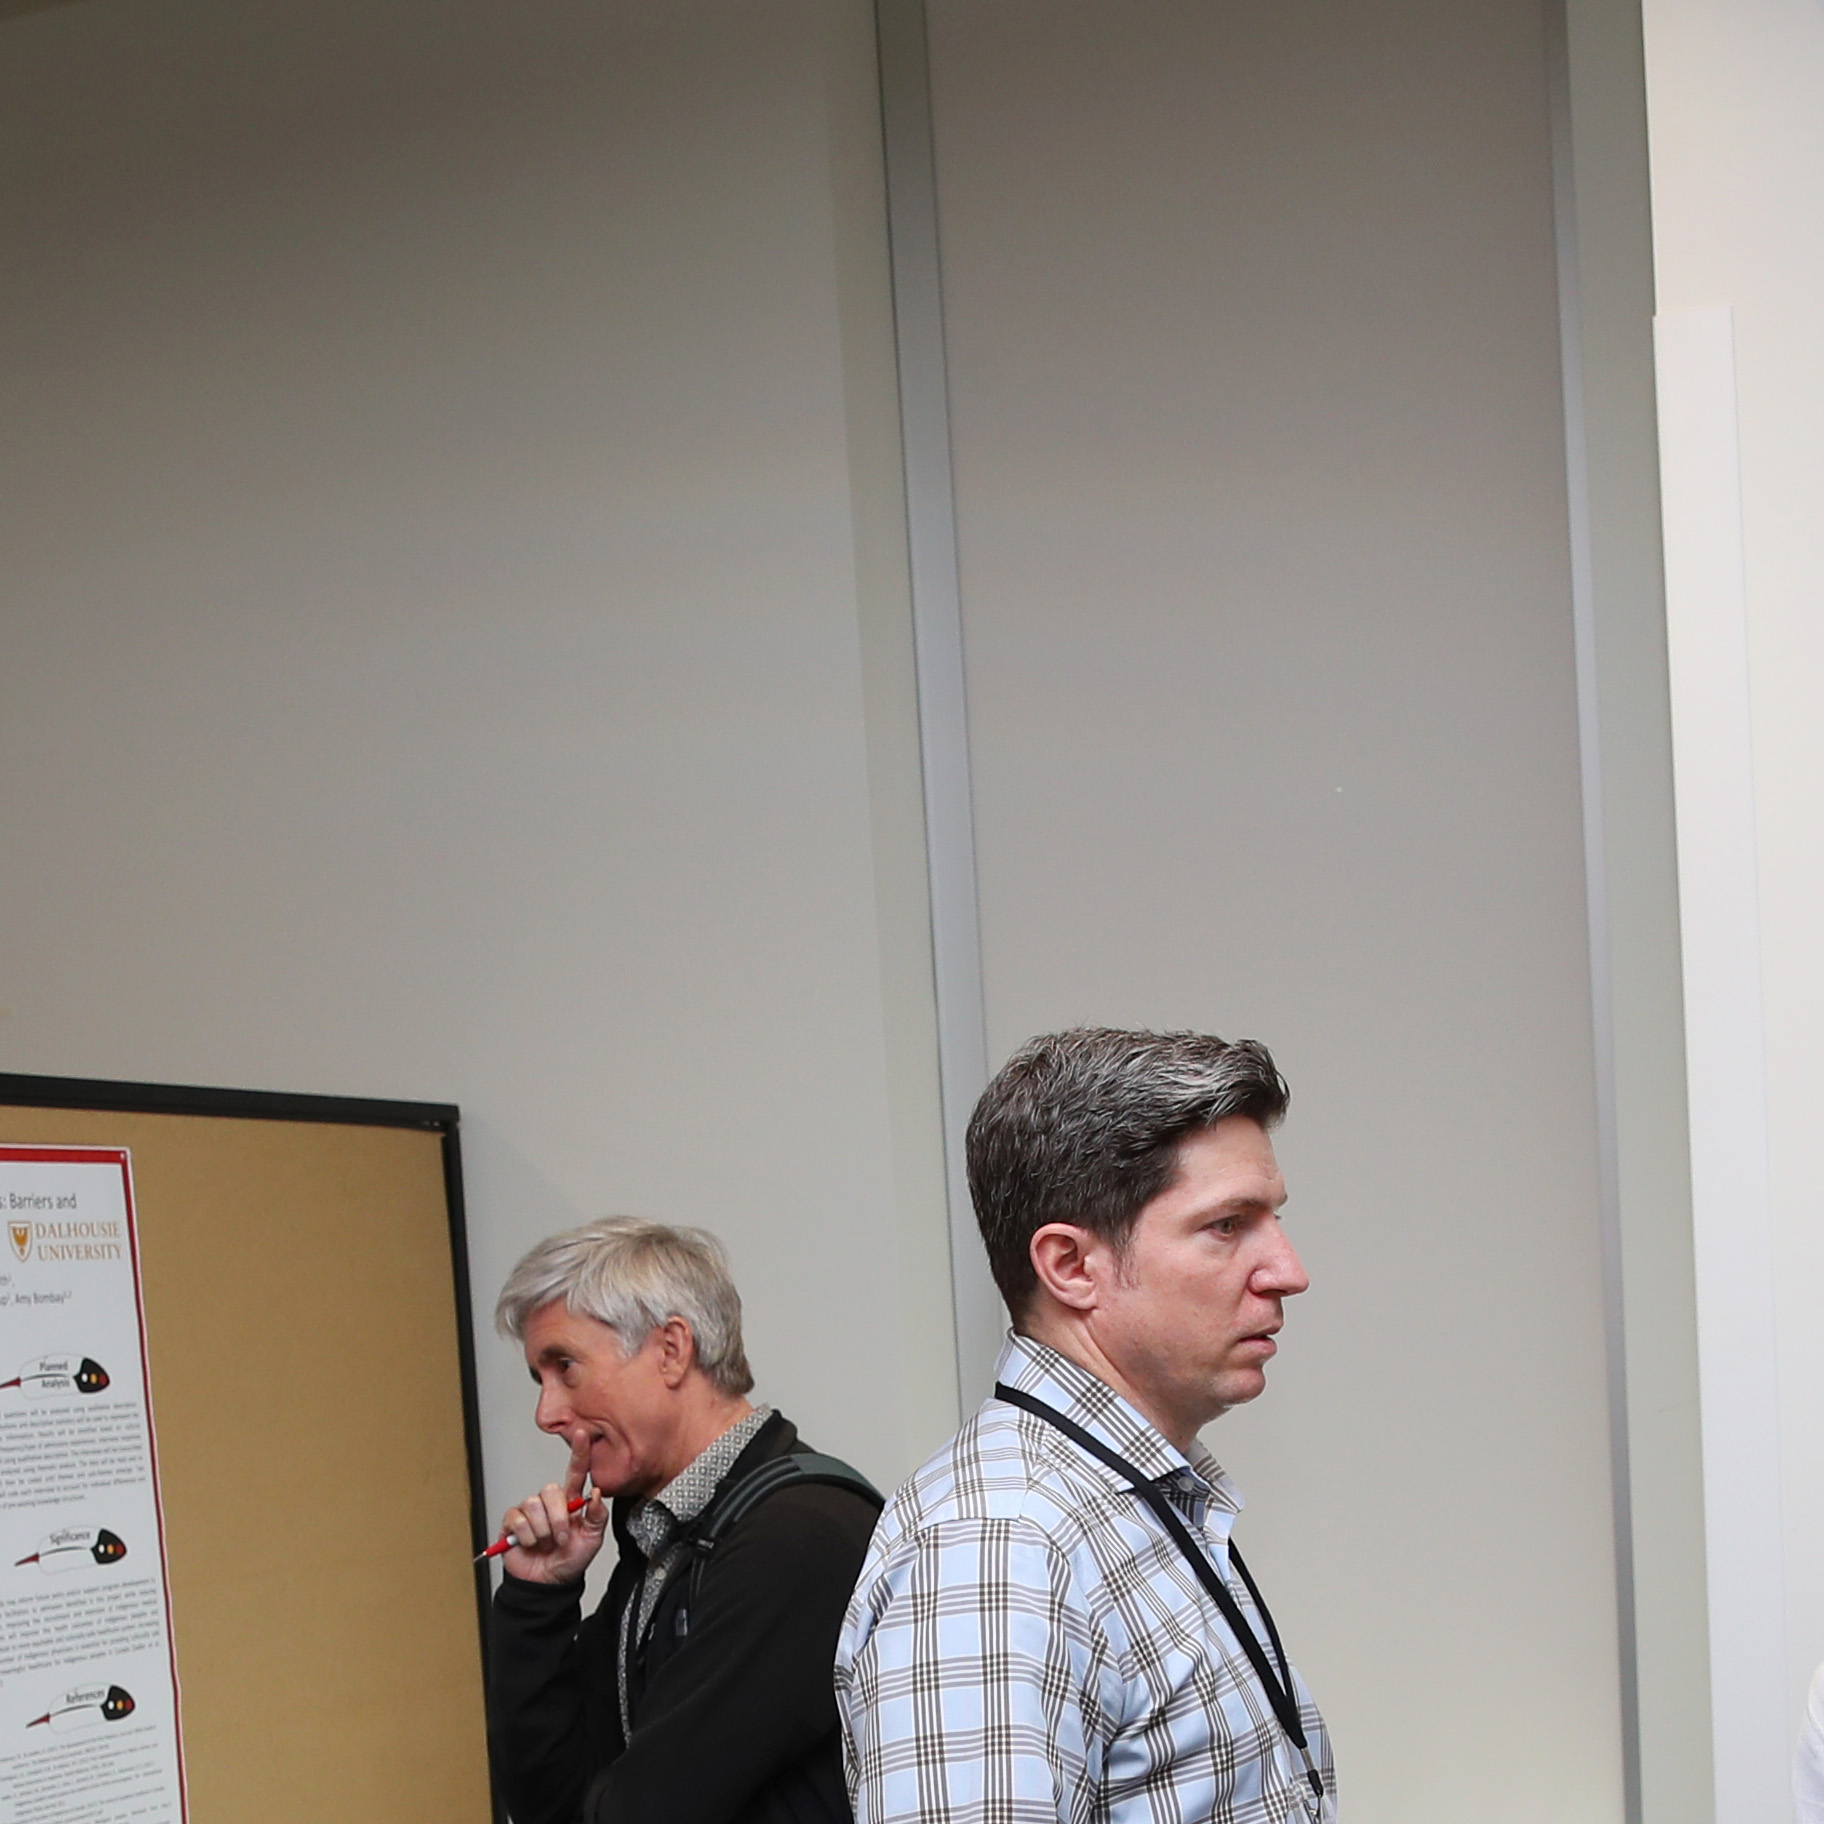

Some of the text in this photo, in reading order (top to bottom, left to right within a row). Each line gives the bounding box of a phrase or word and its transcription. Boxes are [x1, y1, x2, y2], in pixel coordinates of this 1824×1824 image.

[9, 1193, 52, 1209] Barriers
[56, 1193, 76, 1208] and
[34, 1221, 120, 1239] DALHOUSIE
[37, 1244, 123, 1262] UNIVERSITY
[39, 1361, 68, 1371] Planned
[41, 1378, 70, 1390] Analysis
[49, 1531, 90, 1545] Significance
[65, 1689, 105, 1704] References
